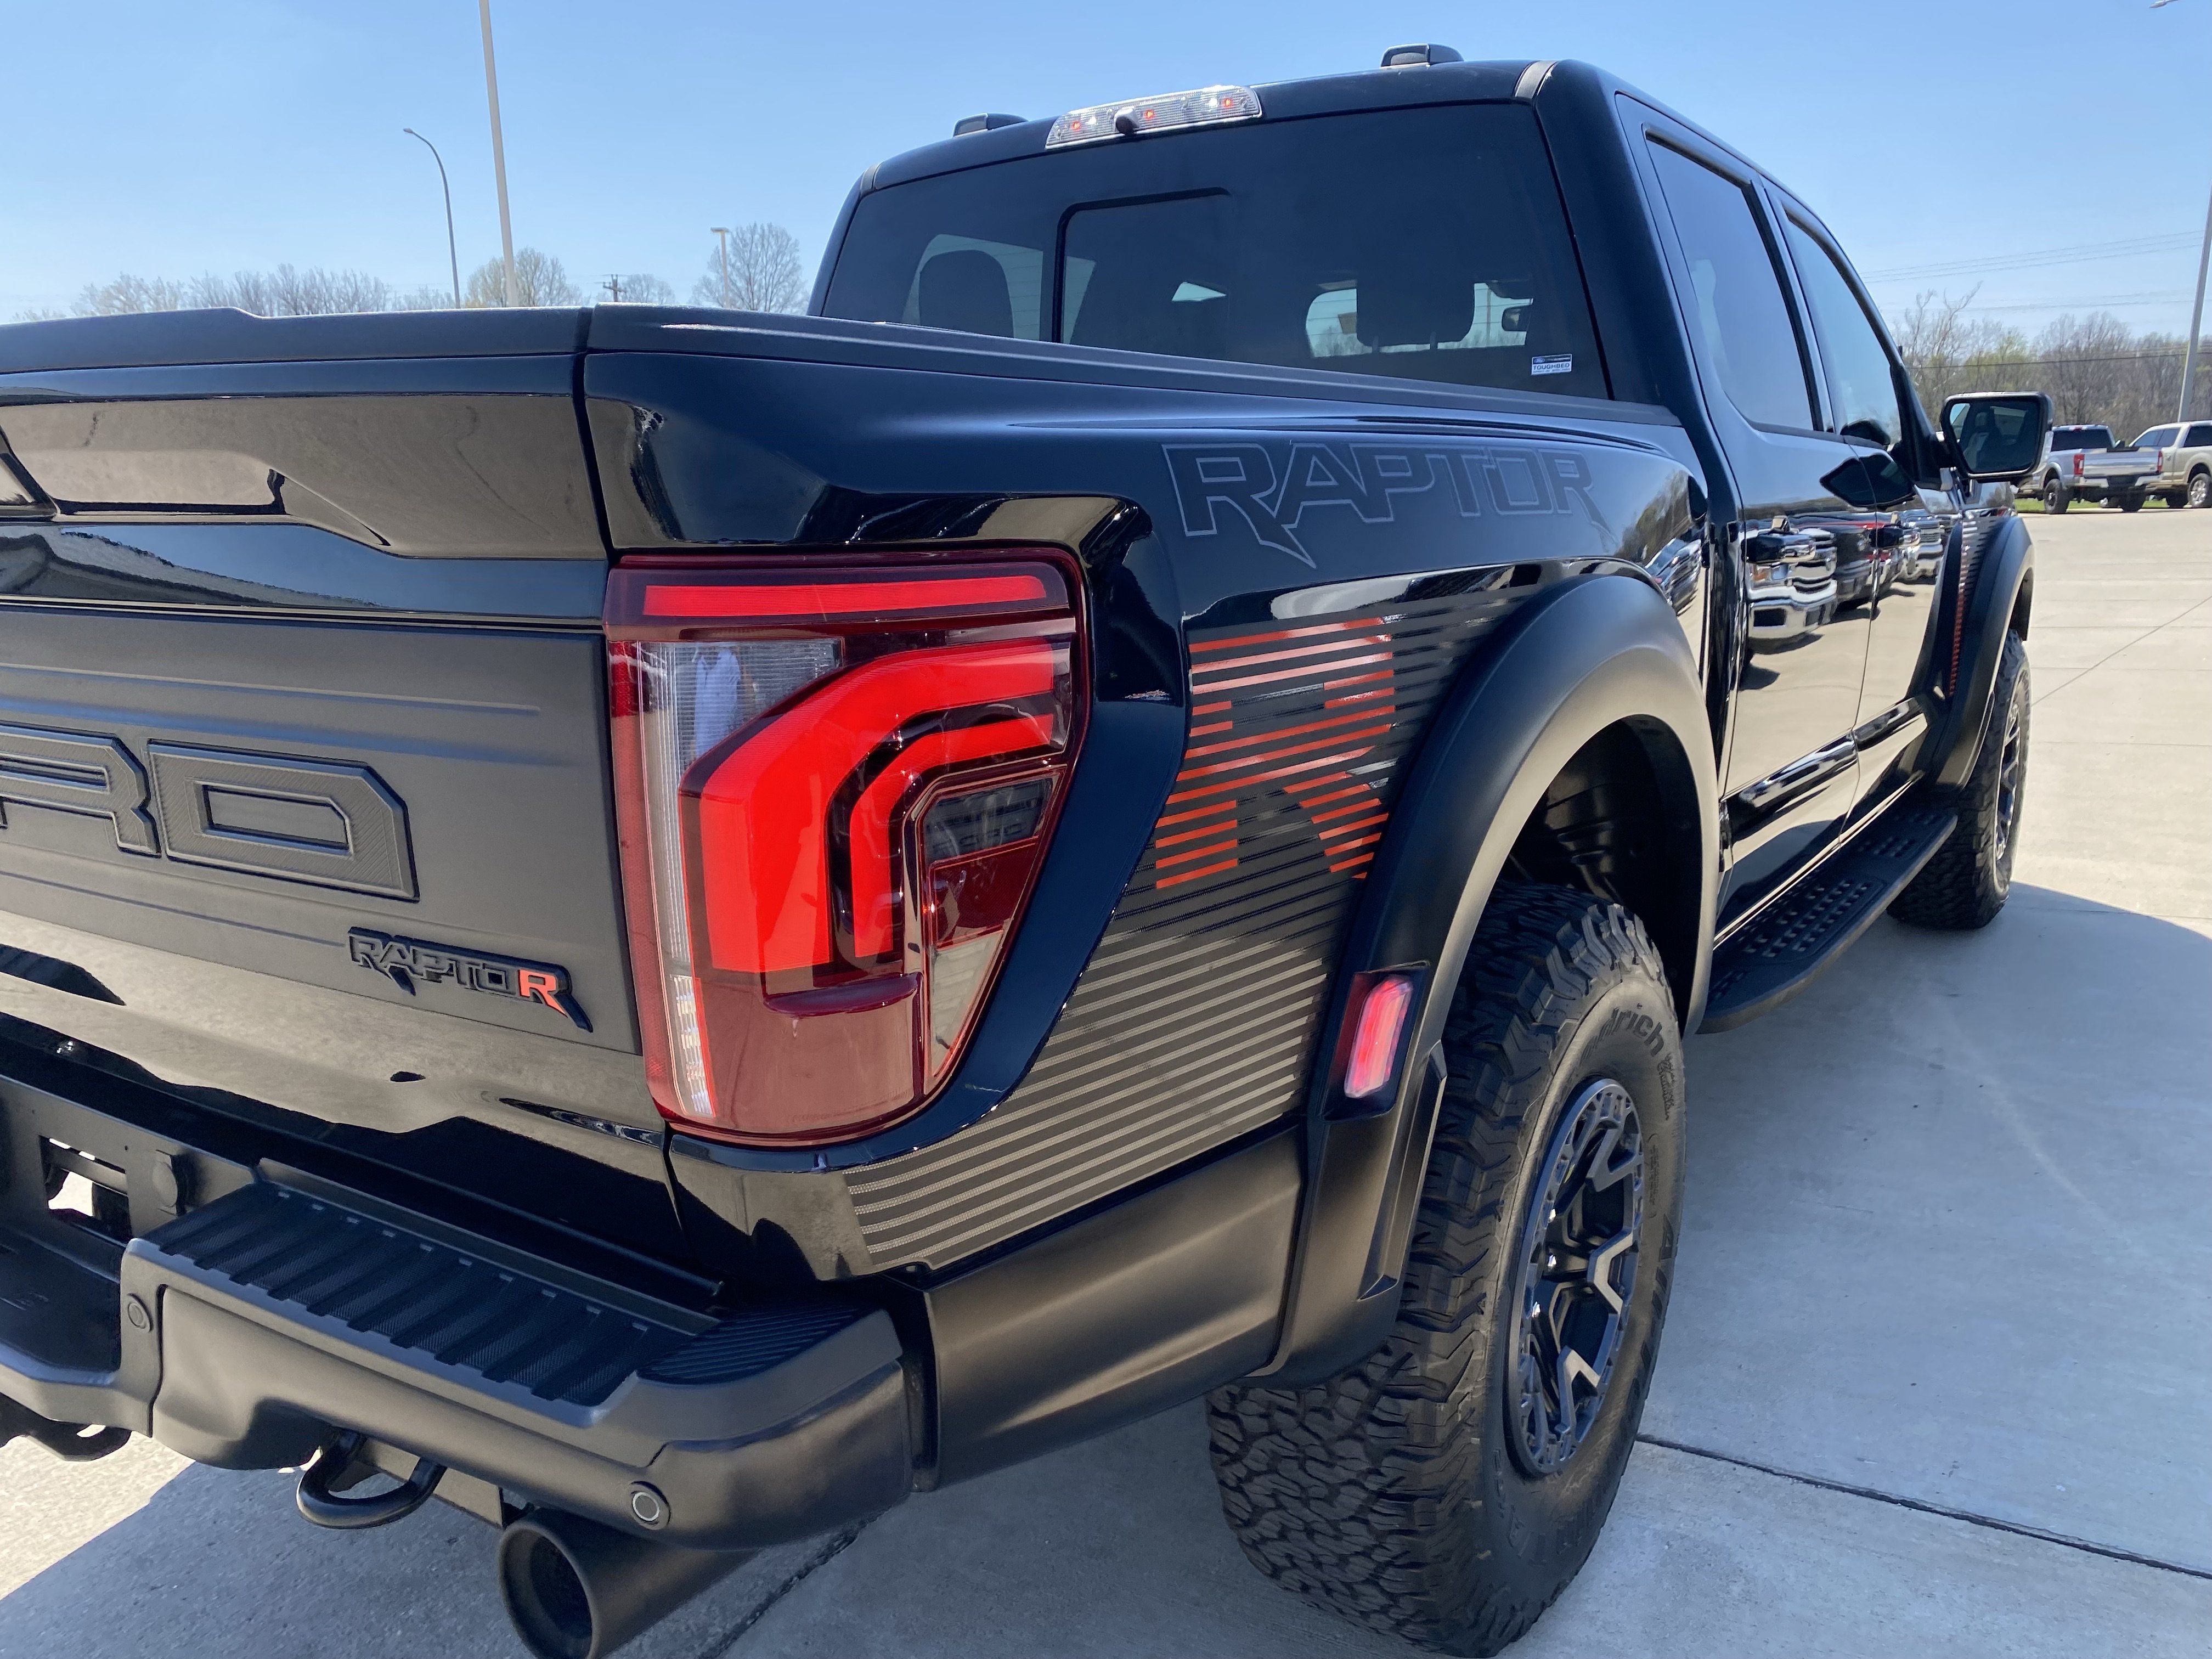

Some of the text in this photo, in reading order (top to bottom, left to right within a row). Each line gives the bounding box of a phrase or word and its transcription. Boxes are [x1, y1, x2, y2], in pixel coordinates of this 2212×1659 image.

[1162, 443, 1621, 569] RAPTOR
[0, 720, 420, 904] RD
[348, 926, 594, 1033] RAPTOR
